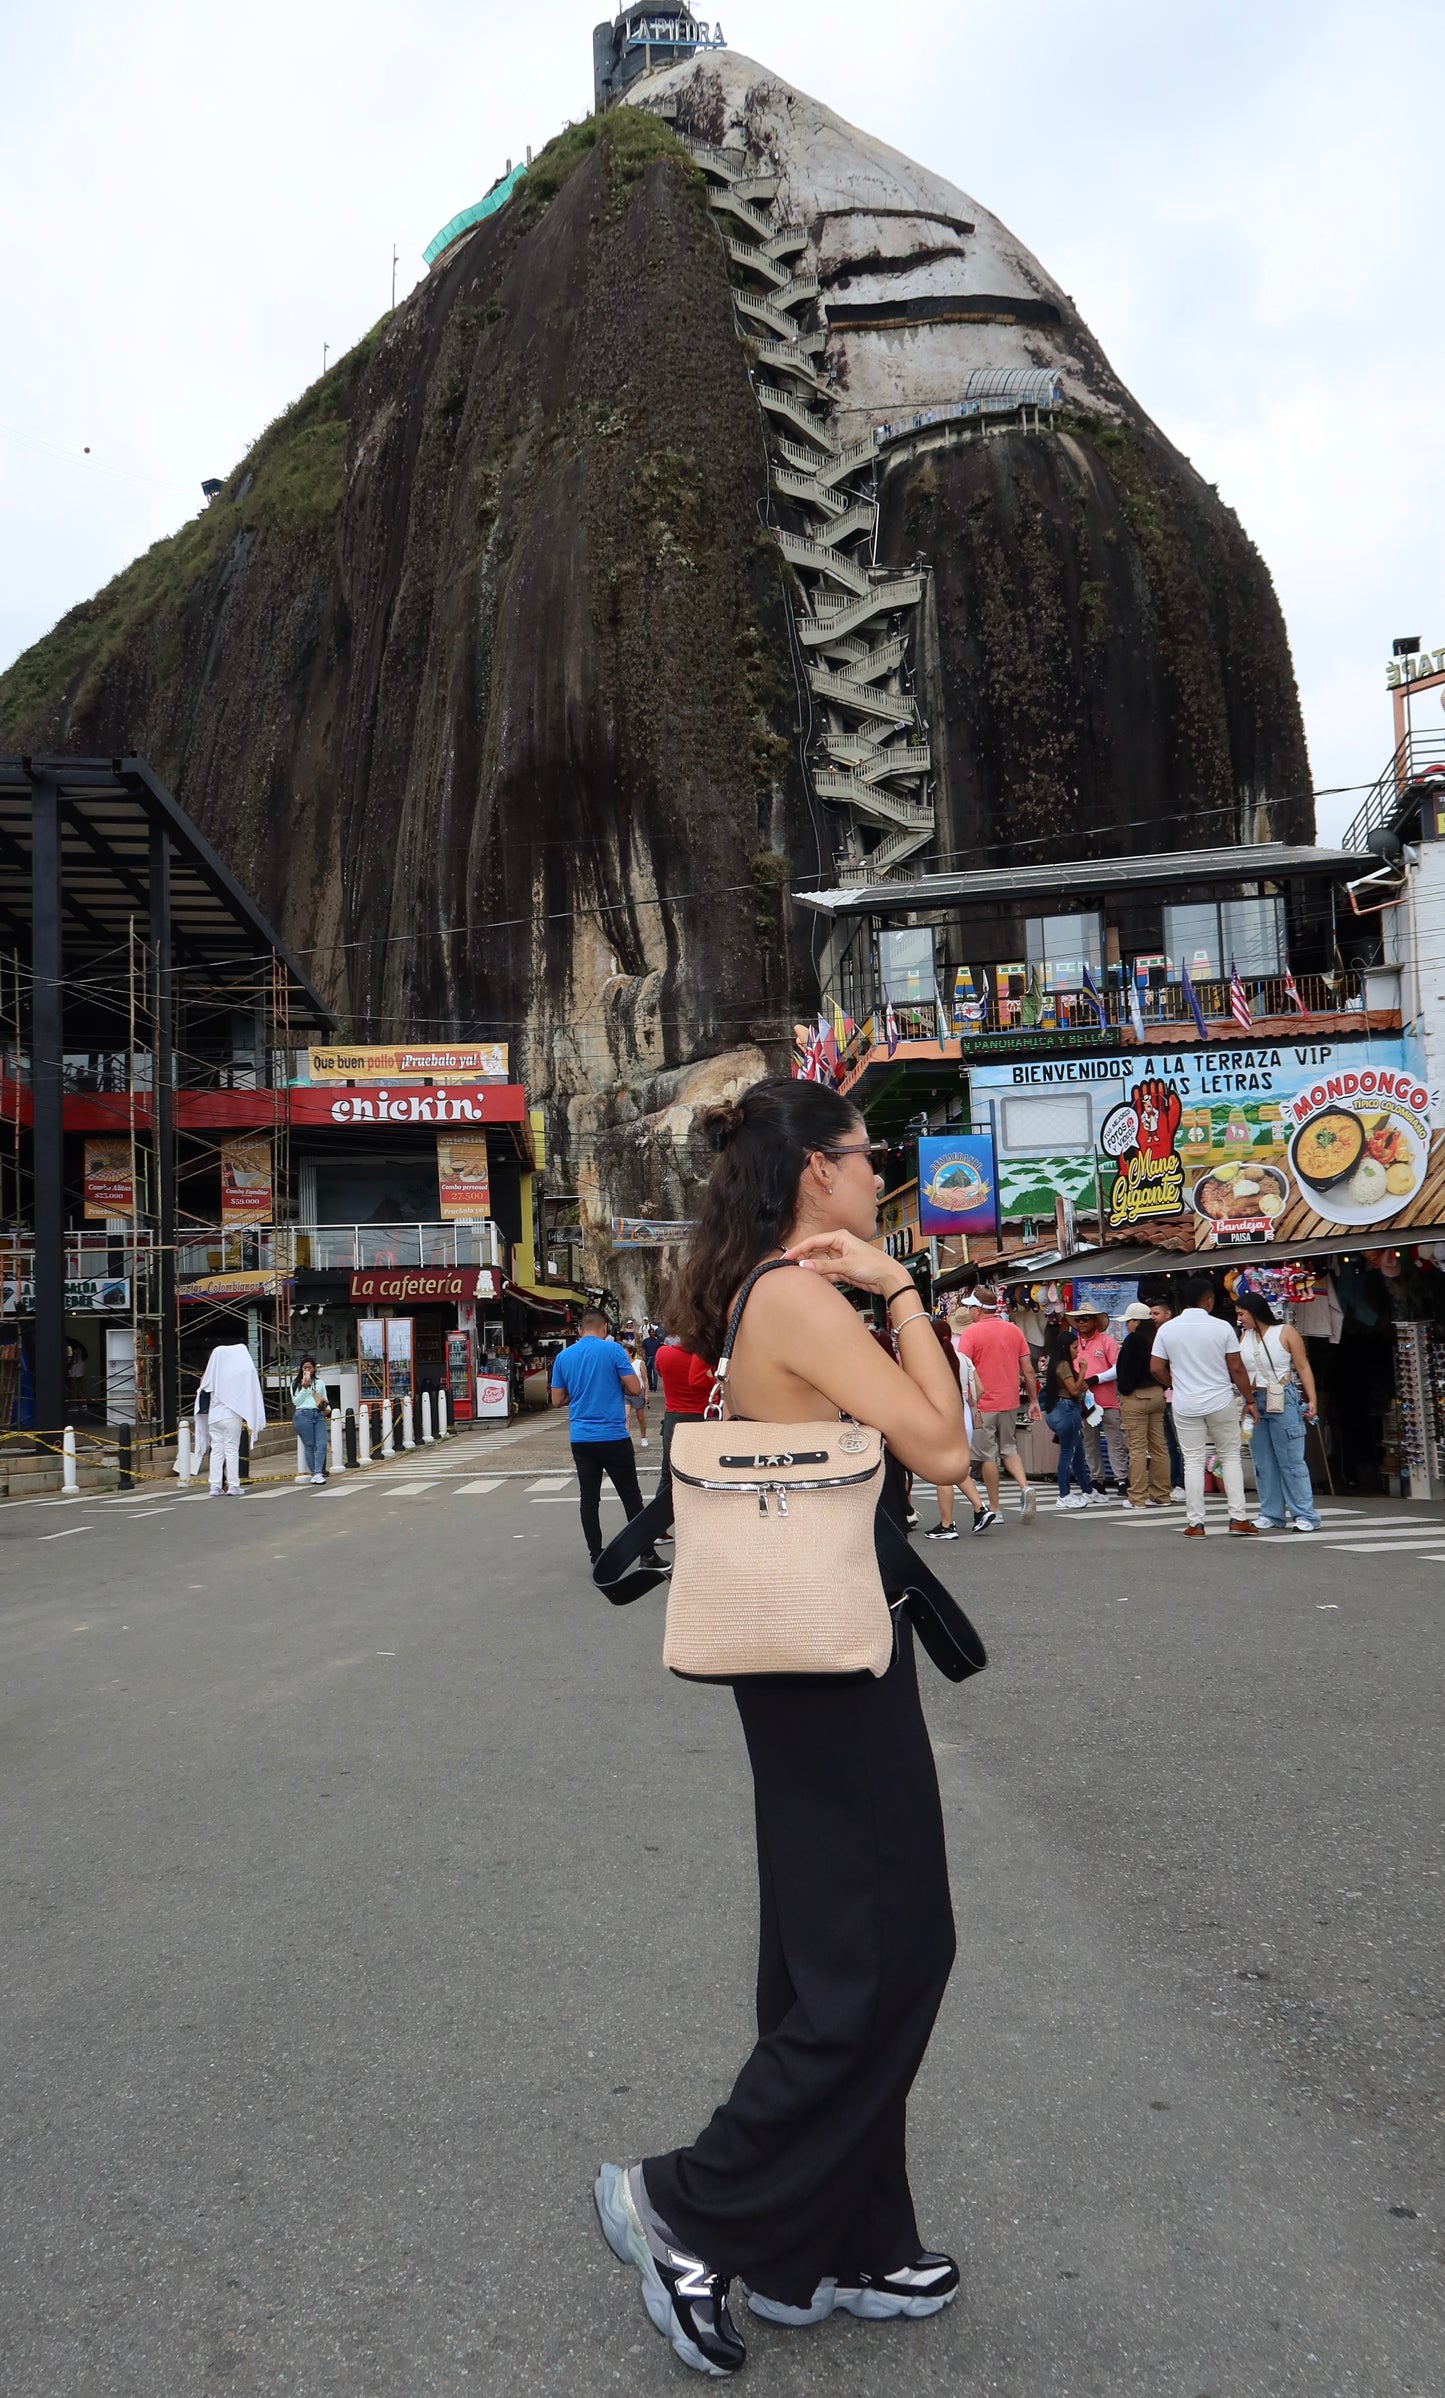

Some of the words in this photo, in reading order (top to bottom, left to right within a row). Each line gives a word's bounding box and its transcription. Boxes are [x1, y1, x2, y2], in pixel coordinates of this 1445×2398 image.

[314, 1055, 335, 1071] Que
[337, 1055, 365, 1069] buen
[367, 1054, 394, 1071] pollo
[459, 1053, 478, 1069] ya!
[1012, 1058, 1134, 1084] BIENVENIDOS
[1144, 1058, 1155, 1075] A
[1163, 1056, 1185, 1074] LA
[1193, 1050, 1282, 1072] TERRAZA
[1165, 1077, 1191, 1095] AS
[1201, 1072, 1273, 1094] LETRAS
[1292, 1071, 1429, 1122] MONDONGO
[1381, 1100, 1428, 1140] COLOMBIANO
[1107, 1122, 1127, 1149] FOTOS
[1128, 1148, 1179, 1185] Mano
[451, 1192, 484, 1201] 27.500
[1110, 1174, 1182, 1224] Gigante
[1216, 1220, 1266, 1233] Bandeja
[1231, 1232, 1252, 1243] PAISA
[351, 1276, 373, 1296] La
[379, 1272, 463, 1300] cafetería
